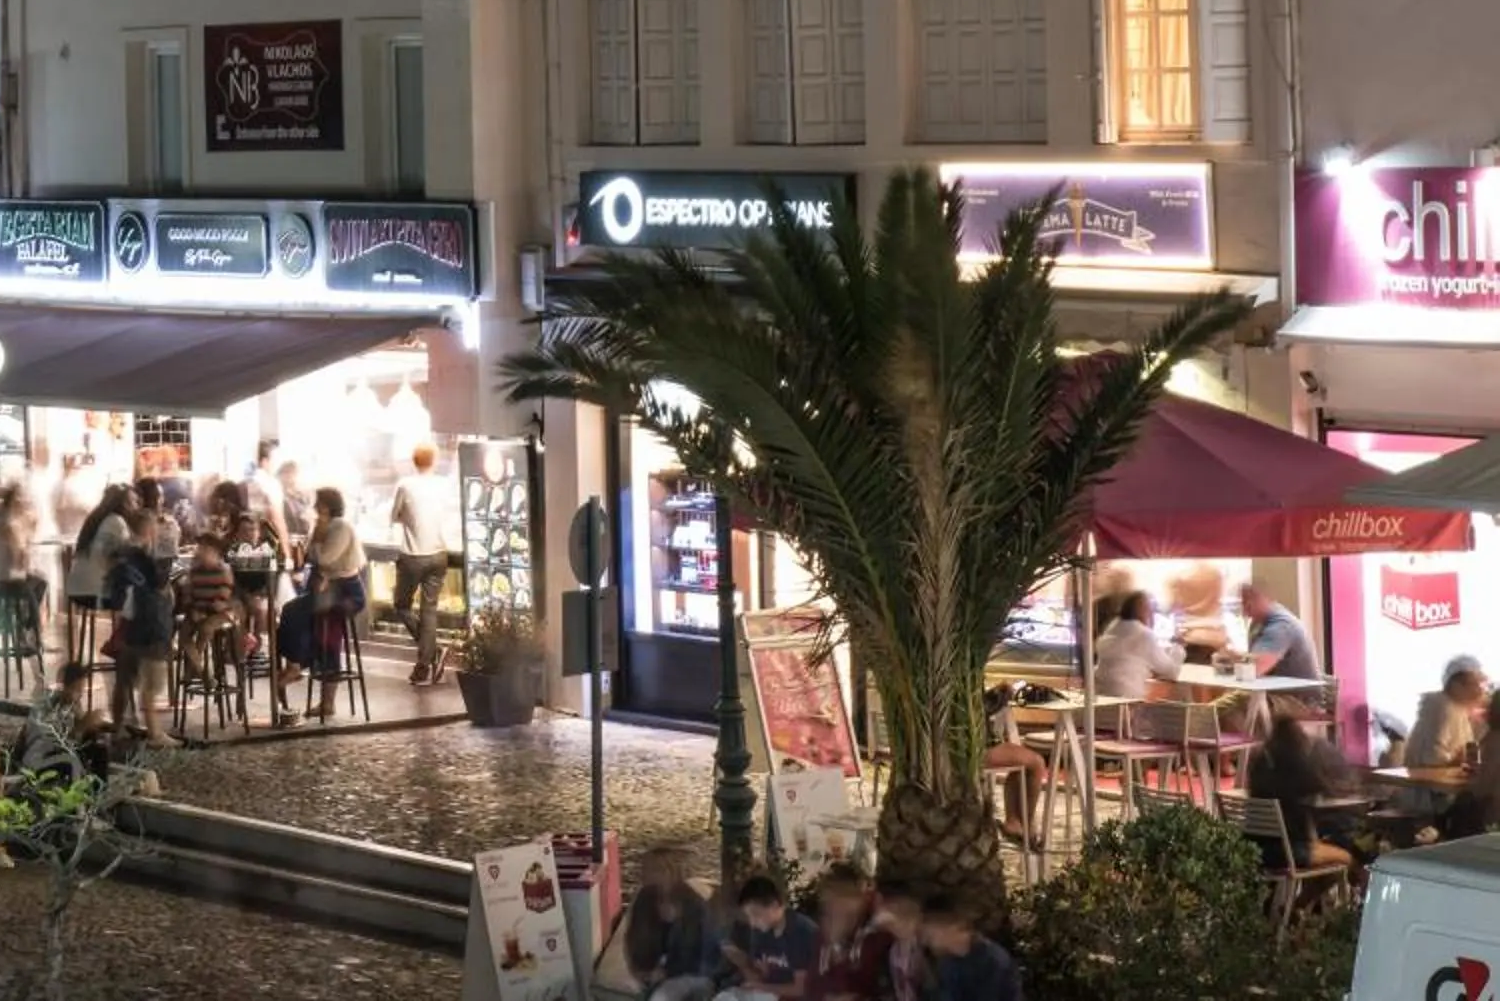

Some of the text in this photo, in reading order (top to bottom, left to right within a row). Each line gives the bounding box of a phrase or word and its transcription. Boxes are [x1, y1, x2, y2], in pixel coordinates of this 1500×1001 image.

[264, 44, 316, 60] NIKOLAOS
[266, 62, 313, 78] VLACHOS
[646, 198, 737, 226] ESPECTRO
[739, 198, 833, 228] OPANS
[1085, 212, 1127, 232] LATTE
[1376, 180, 1500, 263] chil
[17, 240, 69, 262] FALAFEL
[1377, 273, 1428, 293] ozen
[1313, 510, 1405, 539] chillbox
[1415, 599, 1452, 622] box
